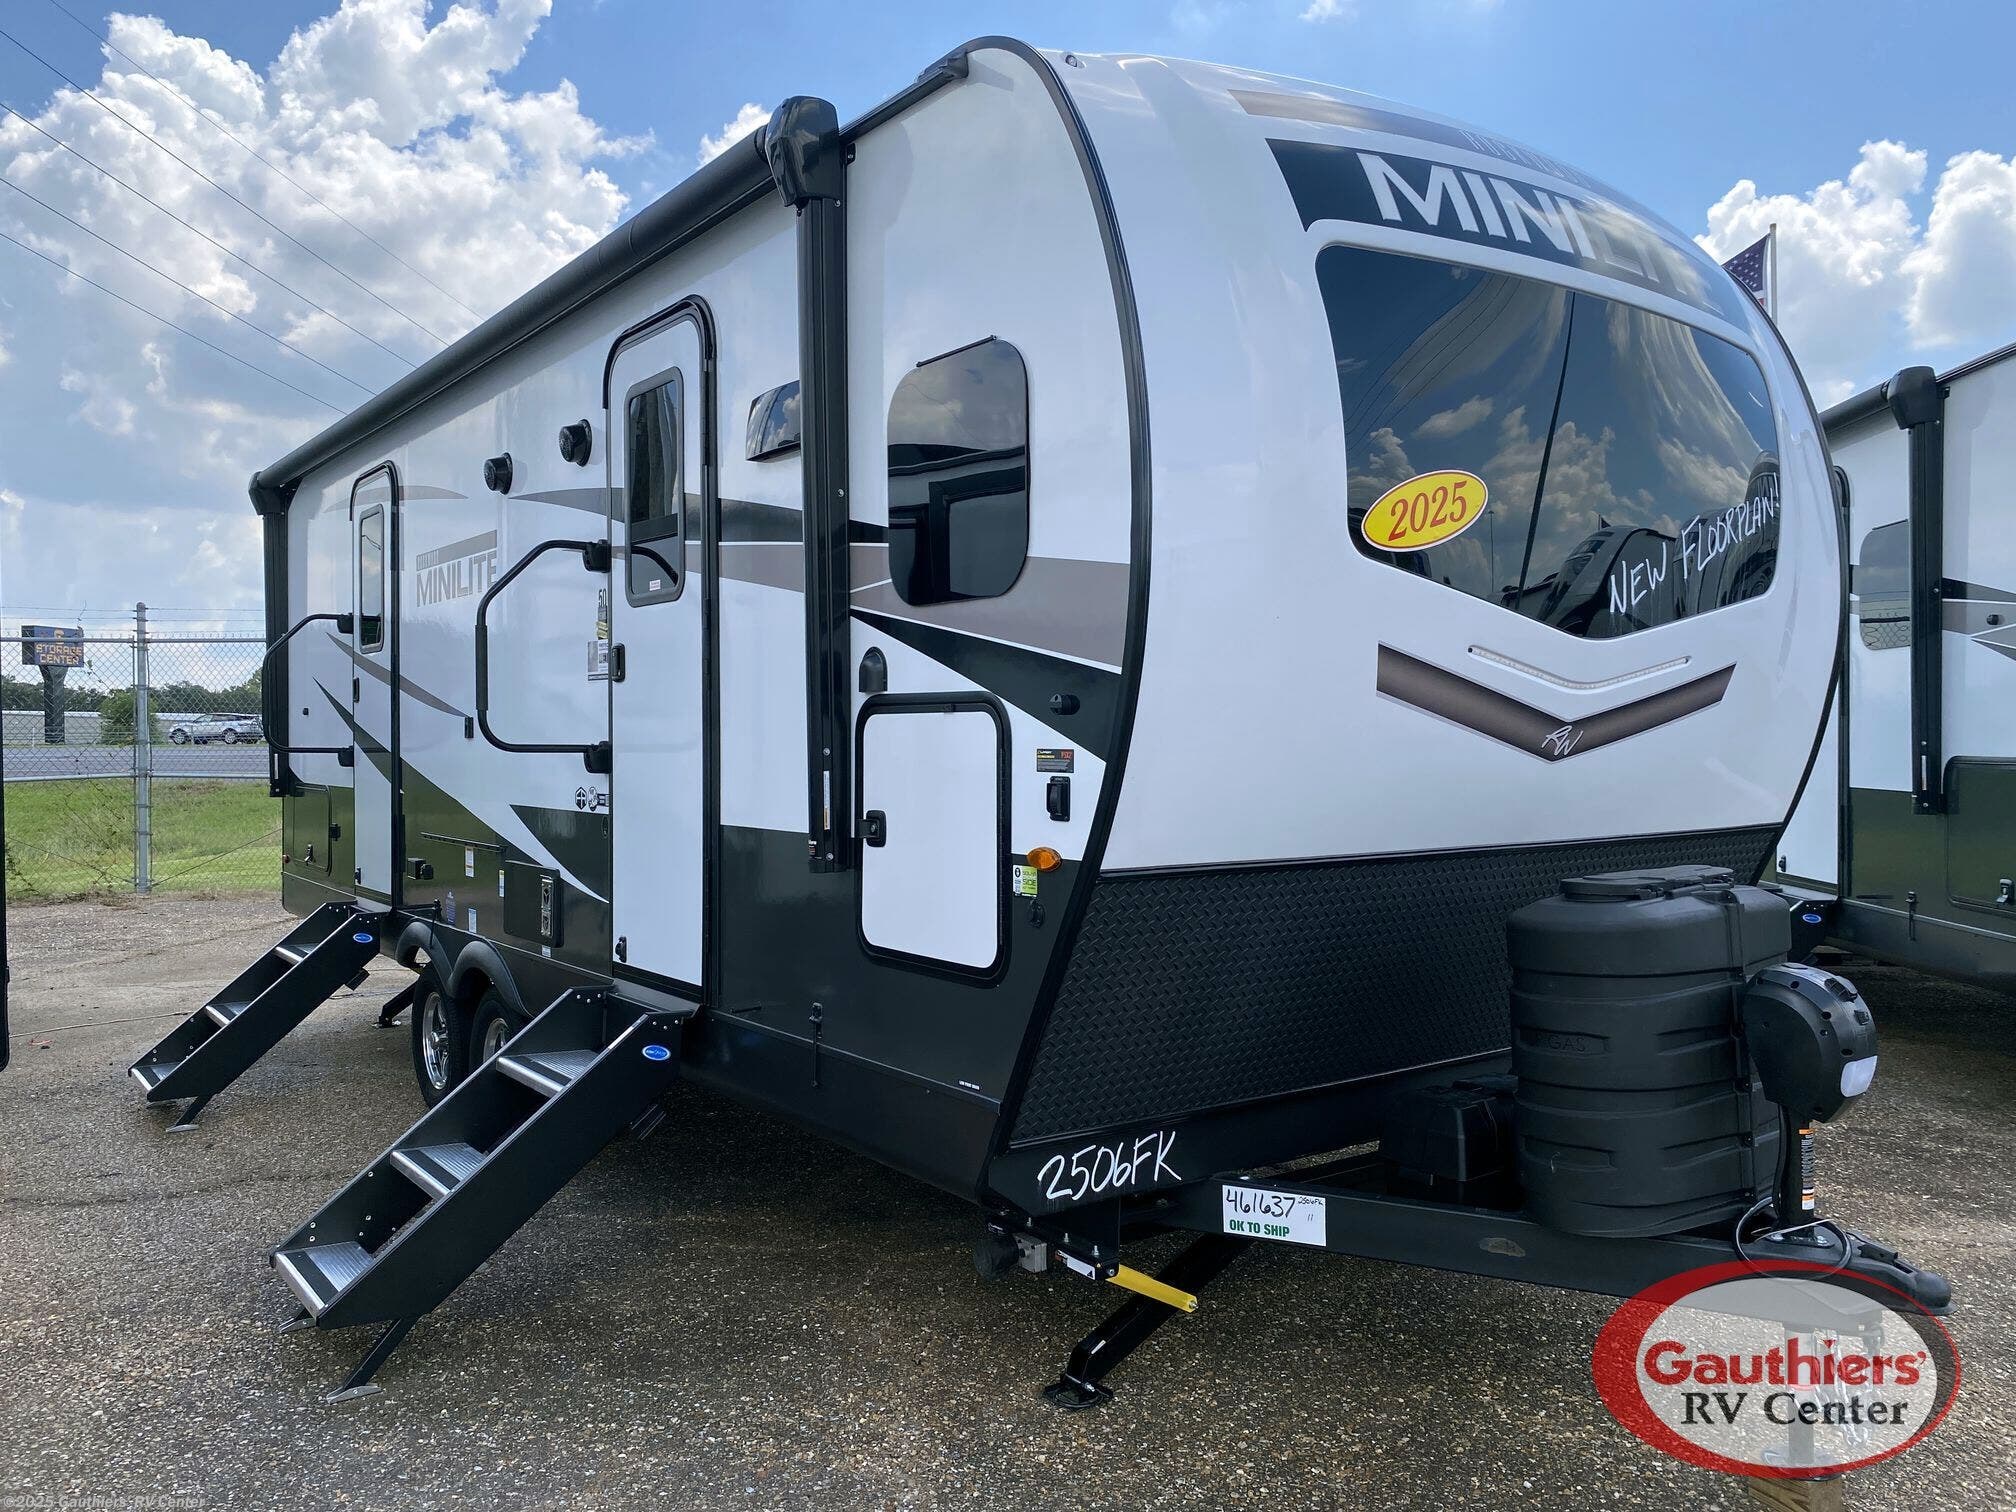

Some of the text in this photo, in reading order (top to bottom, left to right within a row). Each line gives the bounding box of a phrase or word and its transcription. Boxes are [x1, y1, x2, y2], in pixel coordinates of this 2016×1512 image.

[1387, 480, 1468, 542] 2025
[1609, 541, 1667, 615] NEW
[35, 644, 82, 656] STORAGE
[39, 654, 80, 665] CENTER
[1037, 1130, 1182, 1201] 2506FK
[1226, 1188, 1296, 1219] 461637
[1229, 1219, 1290, 1238] OK TO SHIP
